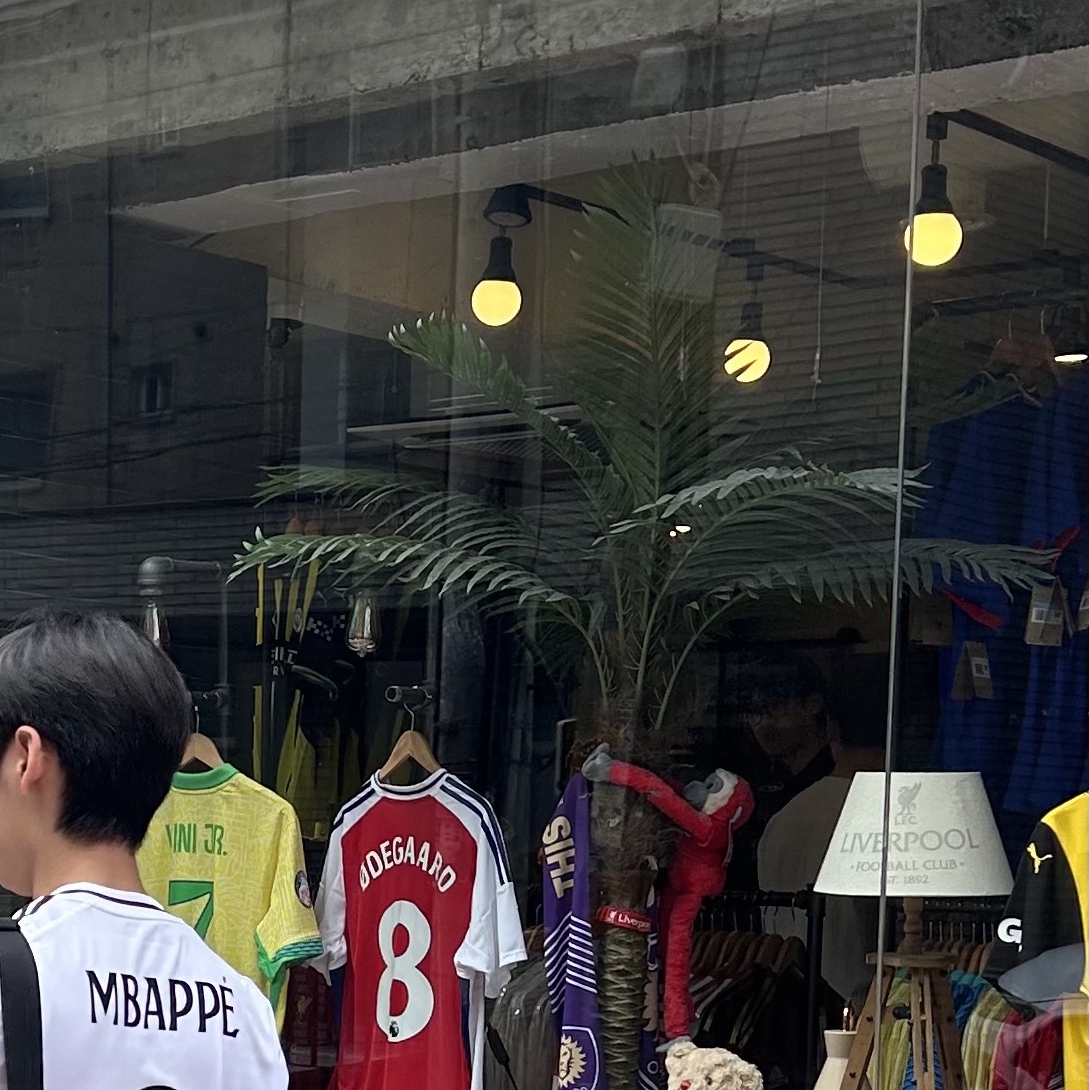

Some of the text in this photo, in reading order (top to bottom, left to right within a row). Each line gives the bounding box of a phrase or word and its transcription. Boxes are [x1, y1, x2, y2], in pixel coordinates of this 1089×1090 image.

[204, 823, 228, 856] JR.
[542, 815, 575, 899] THIS
[840, 828, 980, 853] LIVERPOOL
[855, 859, 958, 872] FOOBALL CLUB
[167, 880, 215, 941] 7
[376, 900, 435, 1043] 8
